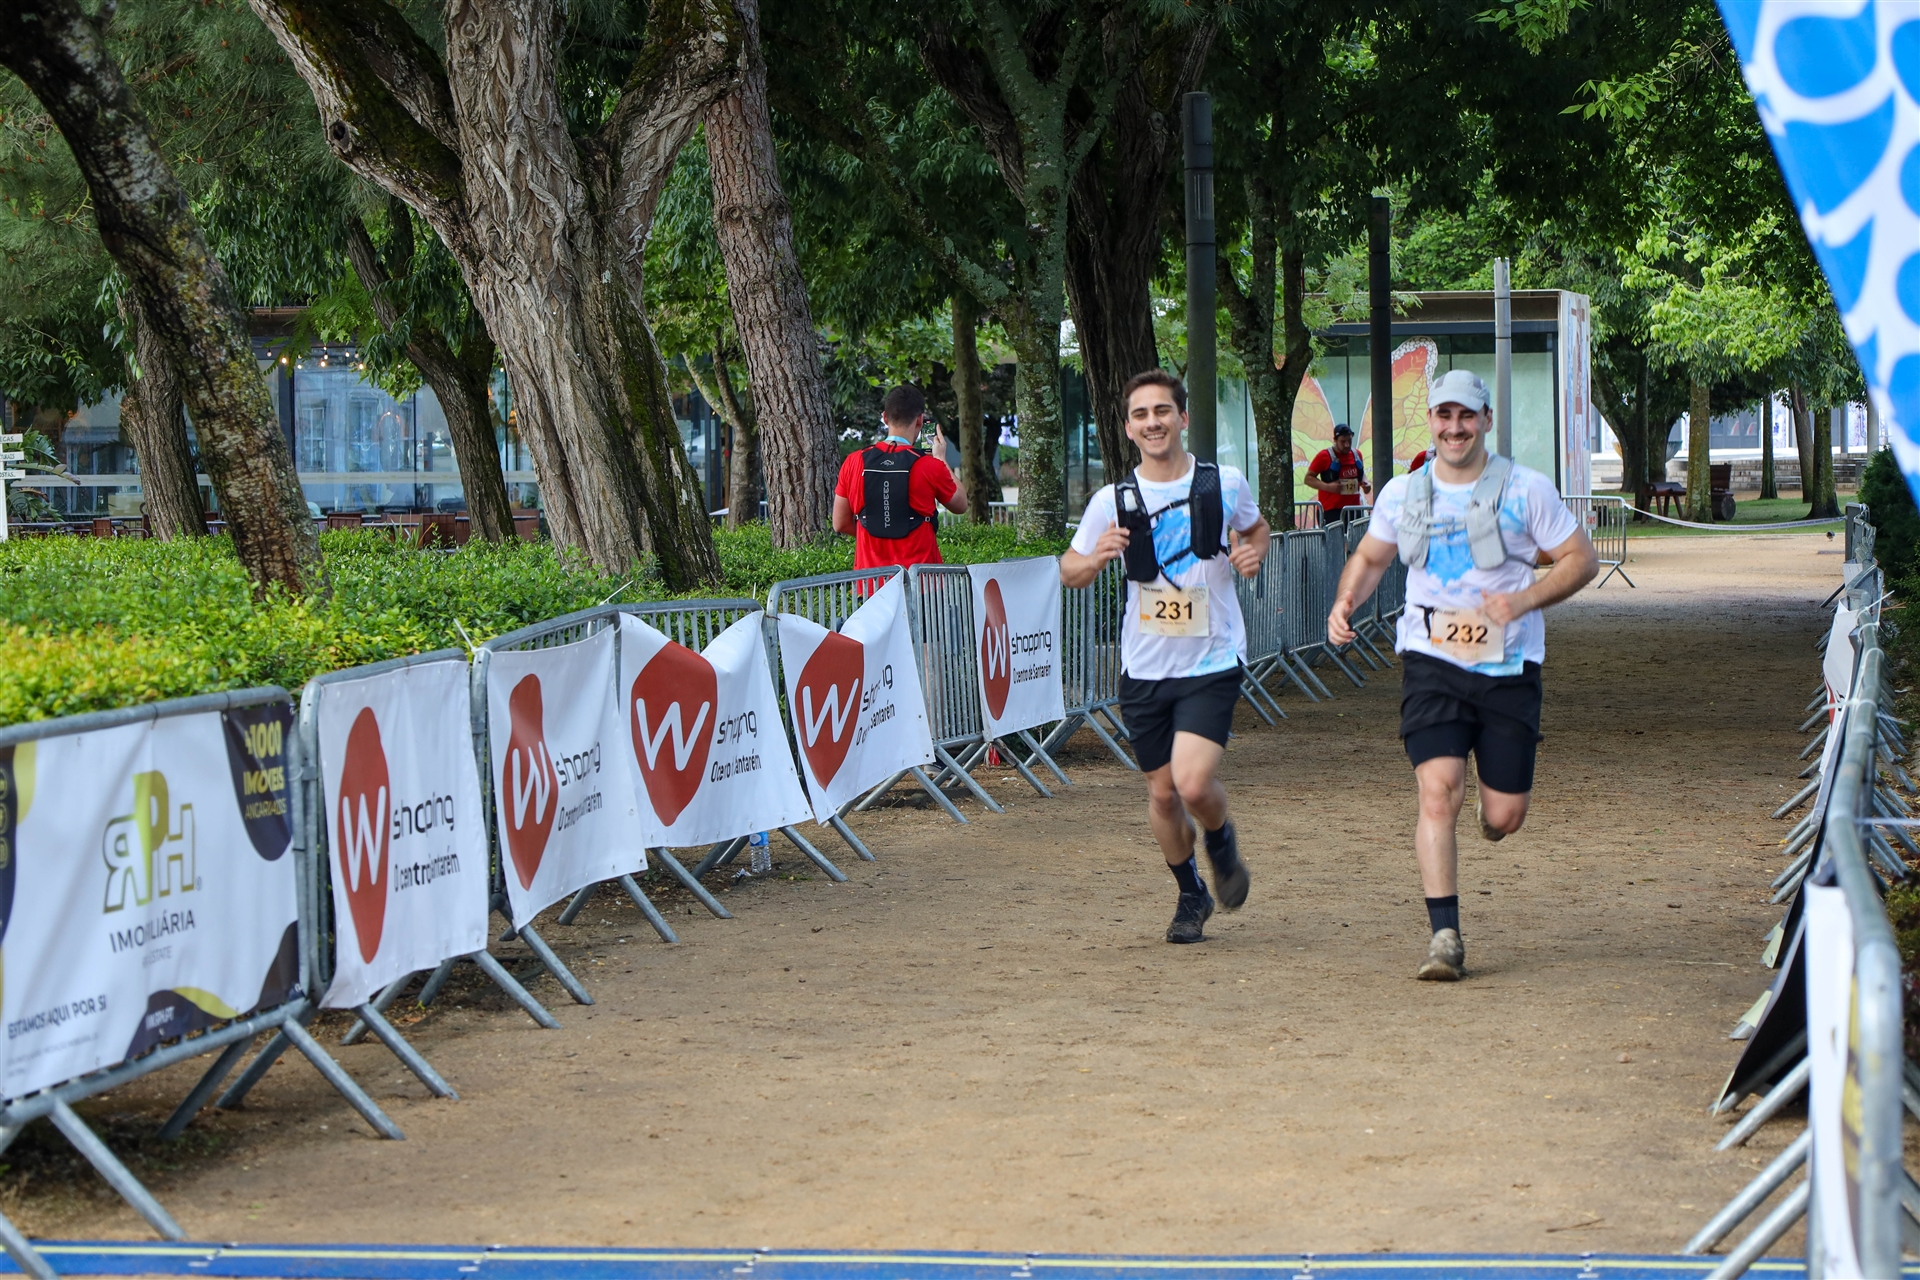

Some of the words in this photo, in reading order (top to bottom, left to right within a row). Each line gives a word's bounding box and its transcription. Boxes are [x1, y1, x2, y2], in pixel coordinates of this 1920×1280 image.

[1155, 600, 1192, 620] 231
[1011, 629, 1051, 656] shopping
[1446, 623, 1488, 645] 232
[71, 998, 97, 1019] POR
